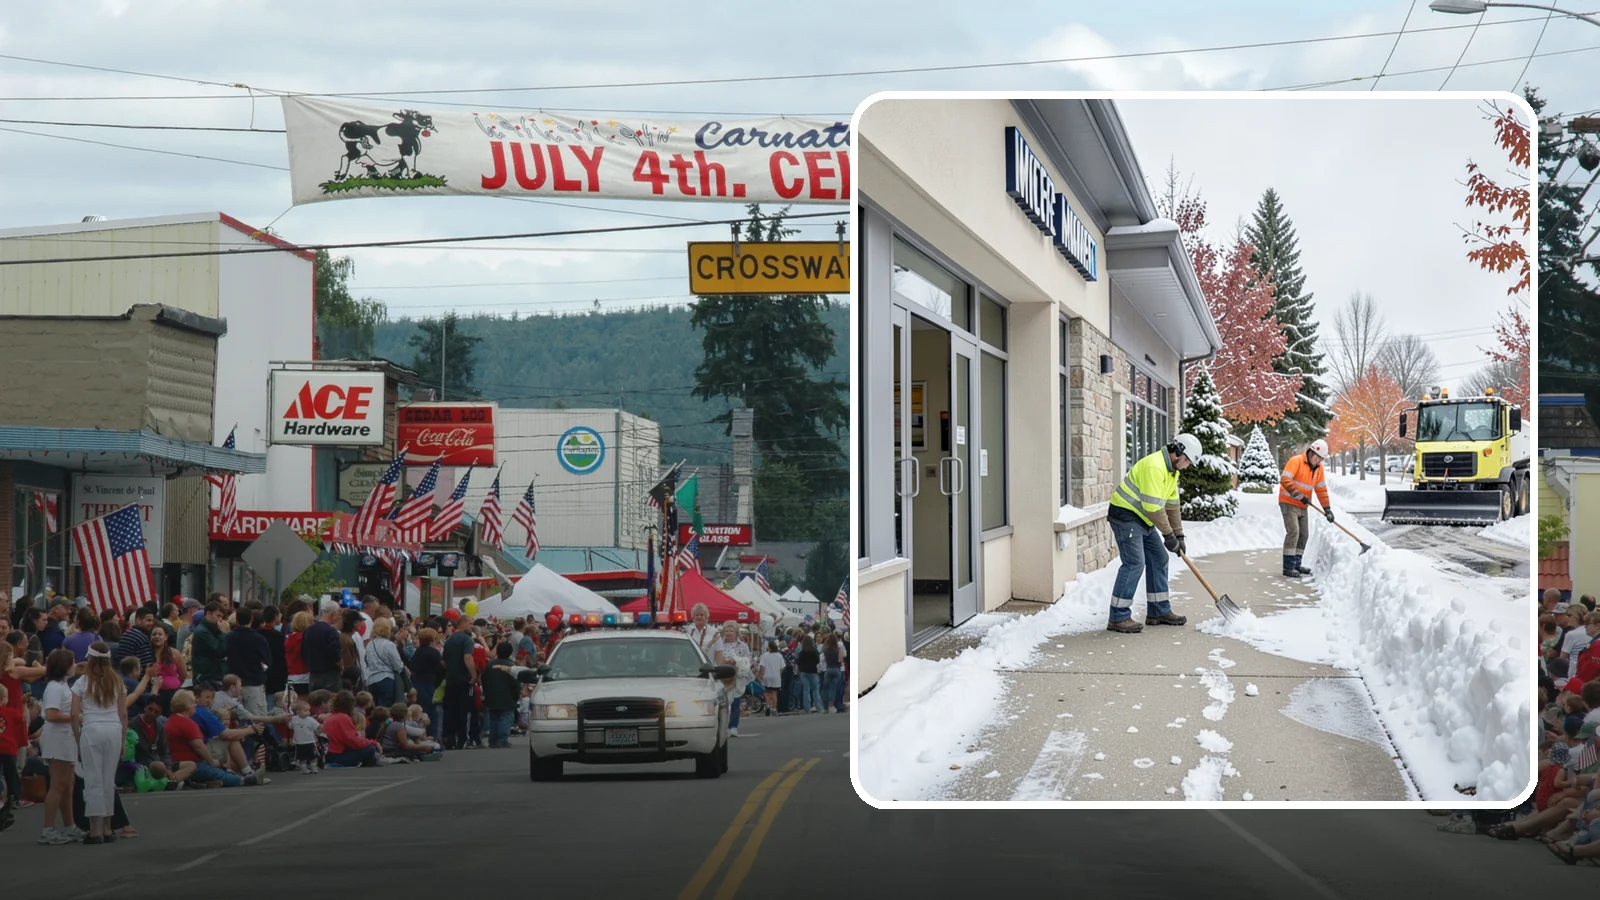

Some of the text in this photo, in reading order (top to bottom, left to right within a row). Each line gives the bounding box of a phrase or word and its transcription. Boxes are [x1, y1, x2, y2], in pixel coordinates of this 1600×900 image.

[695, 121, 850, 150] Carnat
[481, 141, 605, 192] JULY
[632, 150, 746, 198] 4th.
[697, 254, 850, 280] CROSSWA
[282, 379, 374, 420] ACE
[406, 409, 485, 422] CEDAR LOG
[283, 421, 371, 437] Hardware
[416, 428, 477, 447] Coca-Cola
[353, 467, 385, 480] Simpl
[83, 484, 155, 495] St. Vincent de Paul
[212, 515, 331, 536] HARDARE
[688, 526, 741, 535] CRNATION
[699, 535, 730, 543] GLASS
